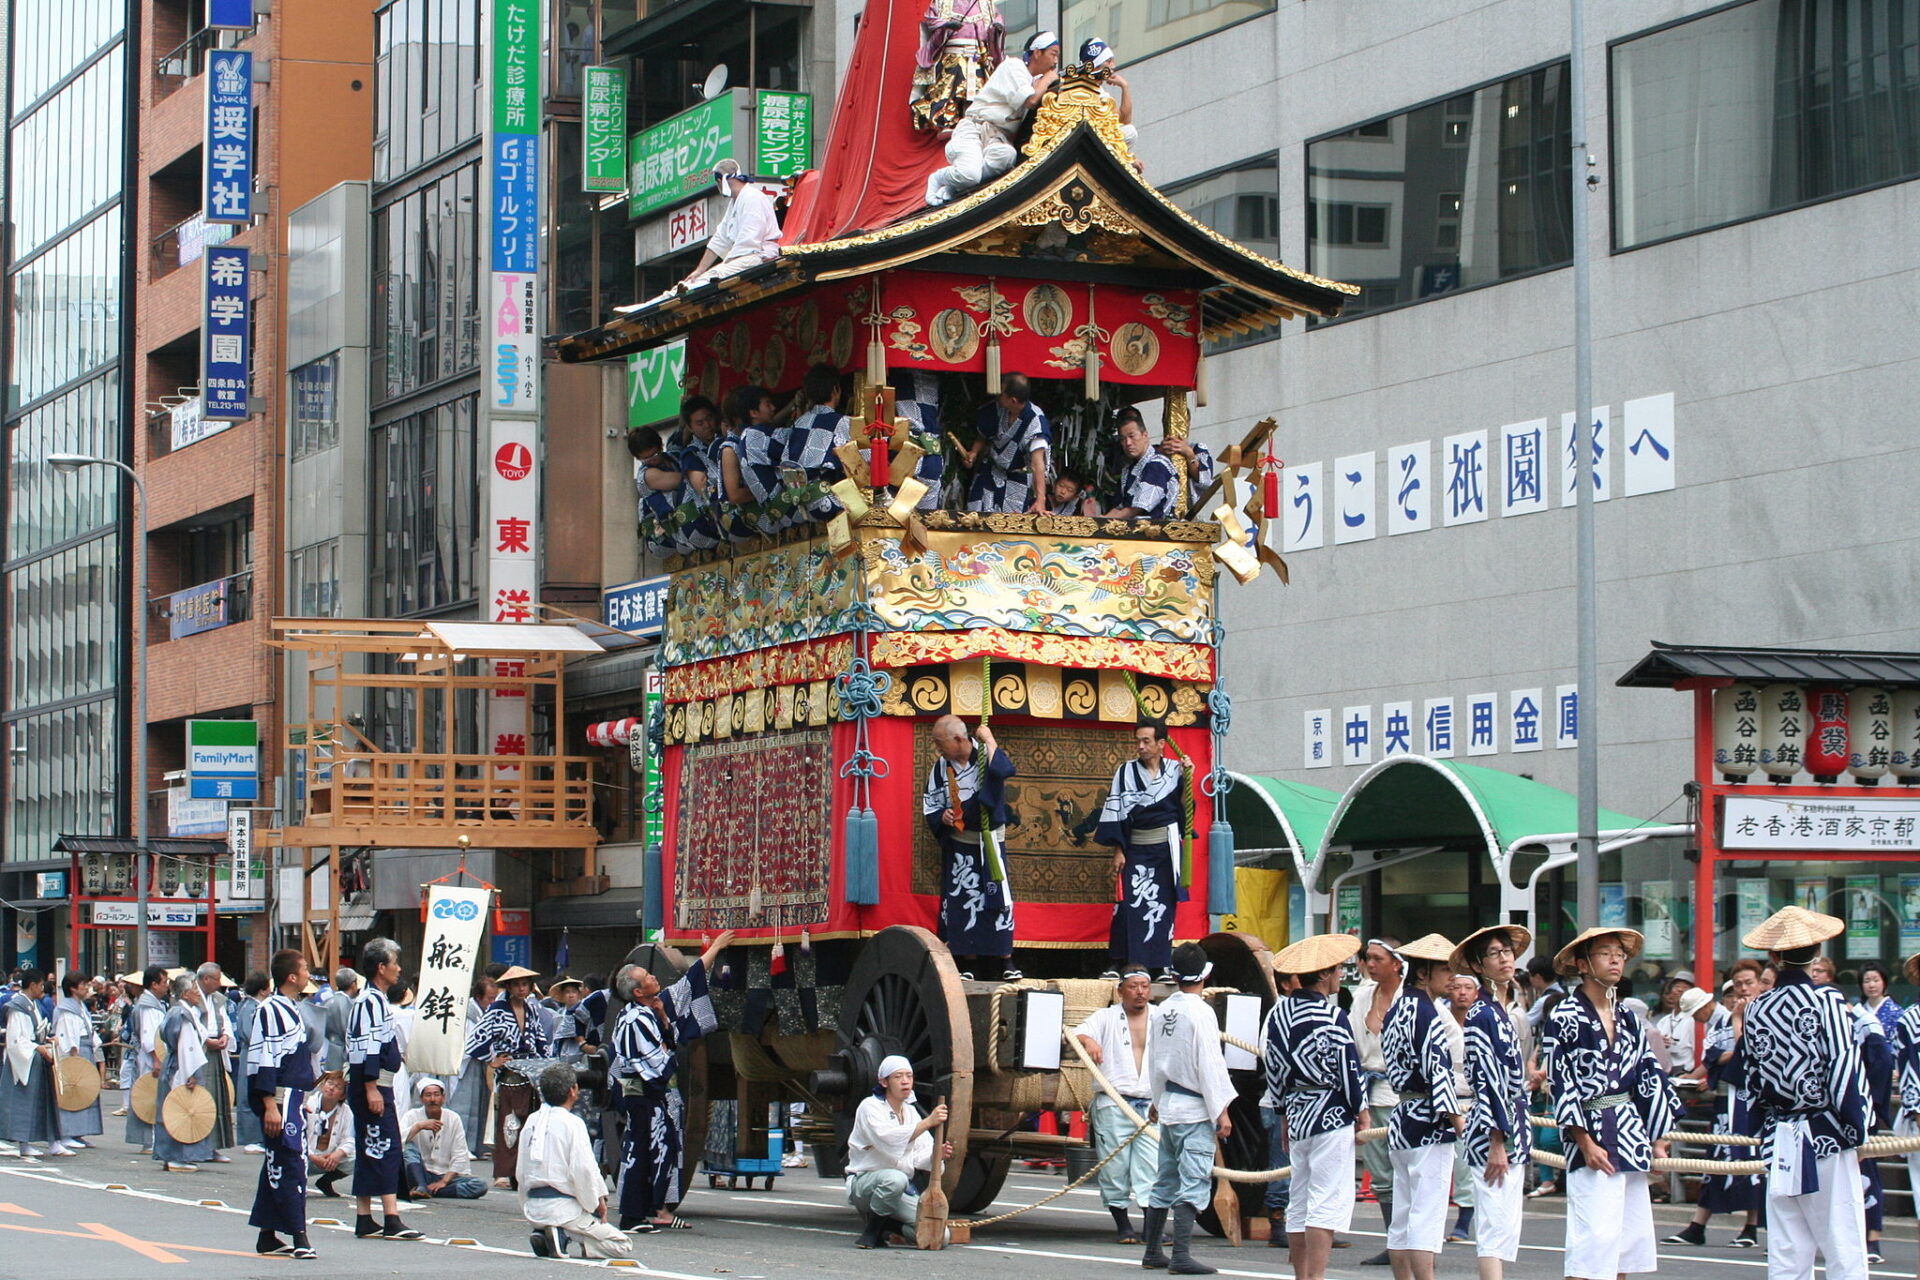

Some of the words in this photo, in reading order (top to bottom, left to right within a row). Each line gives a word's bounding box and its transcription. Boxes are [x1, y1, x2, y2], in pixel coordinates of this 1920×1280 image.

[506, 4, 526, 127] たけだ診療所
[590, 71, 610, 176] 糖尿病センター
[611, 83, 623, 158] 井上クリニック
[650, 106, 712, 153] 井上クリニック
[762, 94, 791, 174] 糖尿病センター
[212, 105, 247, 216] 奨学社
[632, 125, 732, 198] 糖尿病センター
[670, 205, 706, 248] 内科
[210, 256, 245, 364] 希学園
[498, 275, 519, 337] TAM
[217, 390, 236, 400] 教室
[502, 469, 526, 478] TOYO
[194, 752, 254, 765] FamilyMart
[1311, 716, 1323, 760] 京都
[1345, 691, 1578, 758] 中央信用金庫
[1734, 690, 1757, 767] 函谷鉾
[1776, 690, 1801, 768] 函谷鉾
[1867, 694, 1890, 769] 函谷鉾
[217, 782, 232, 797] 酒
[1736, 814, 1915, 838] 老香港酒家京都
[236, 817, 246, 891] 岡本会計事務所
[166, 913, 193, 922] SSJ
[419, 934, 463, 1035] 船鉾
